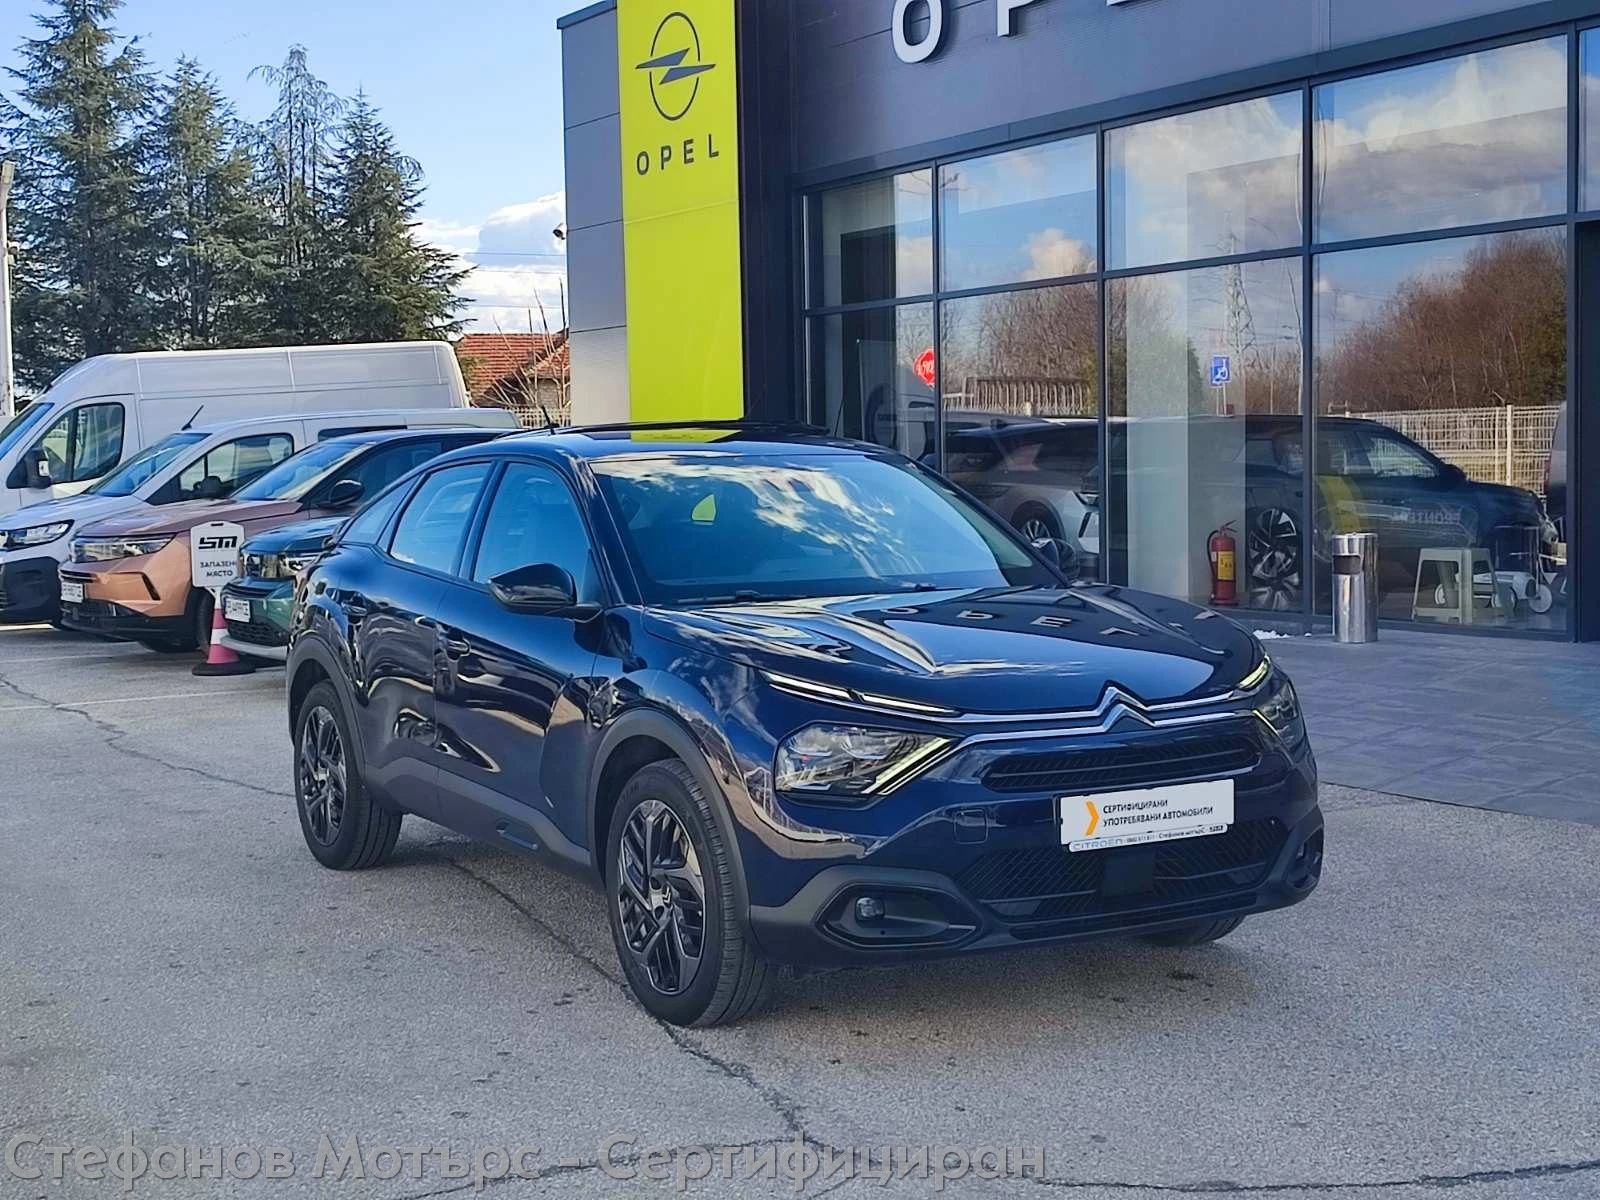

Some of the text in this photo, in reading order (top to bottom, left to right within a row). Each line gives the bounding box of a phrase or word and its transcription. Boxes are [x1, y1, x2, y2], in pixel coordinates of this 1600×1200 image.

[636, 134, 719, 175] OPEL
[1102, 799, 1168, 814] СЕРТИФИЦИРАНИ
[1103, 806, 1213, 827] УПОТРЕБЯВАНИ АВТОМОБИЛИ
